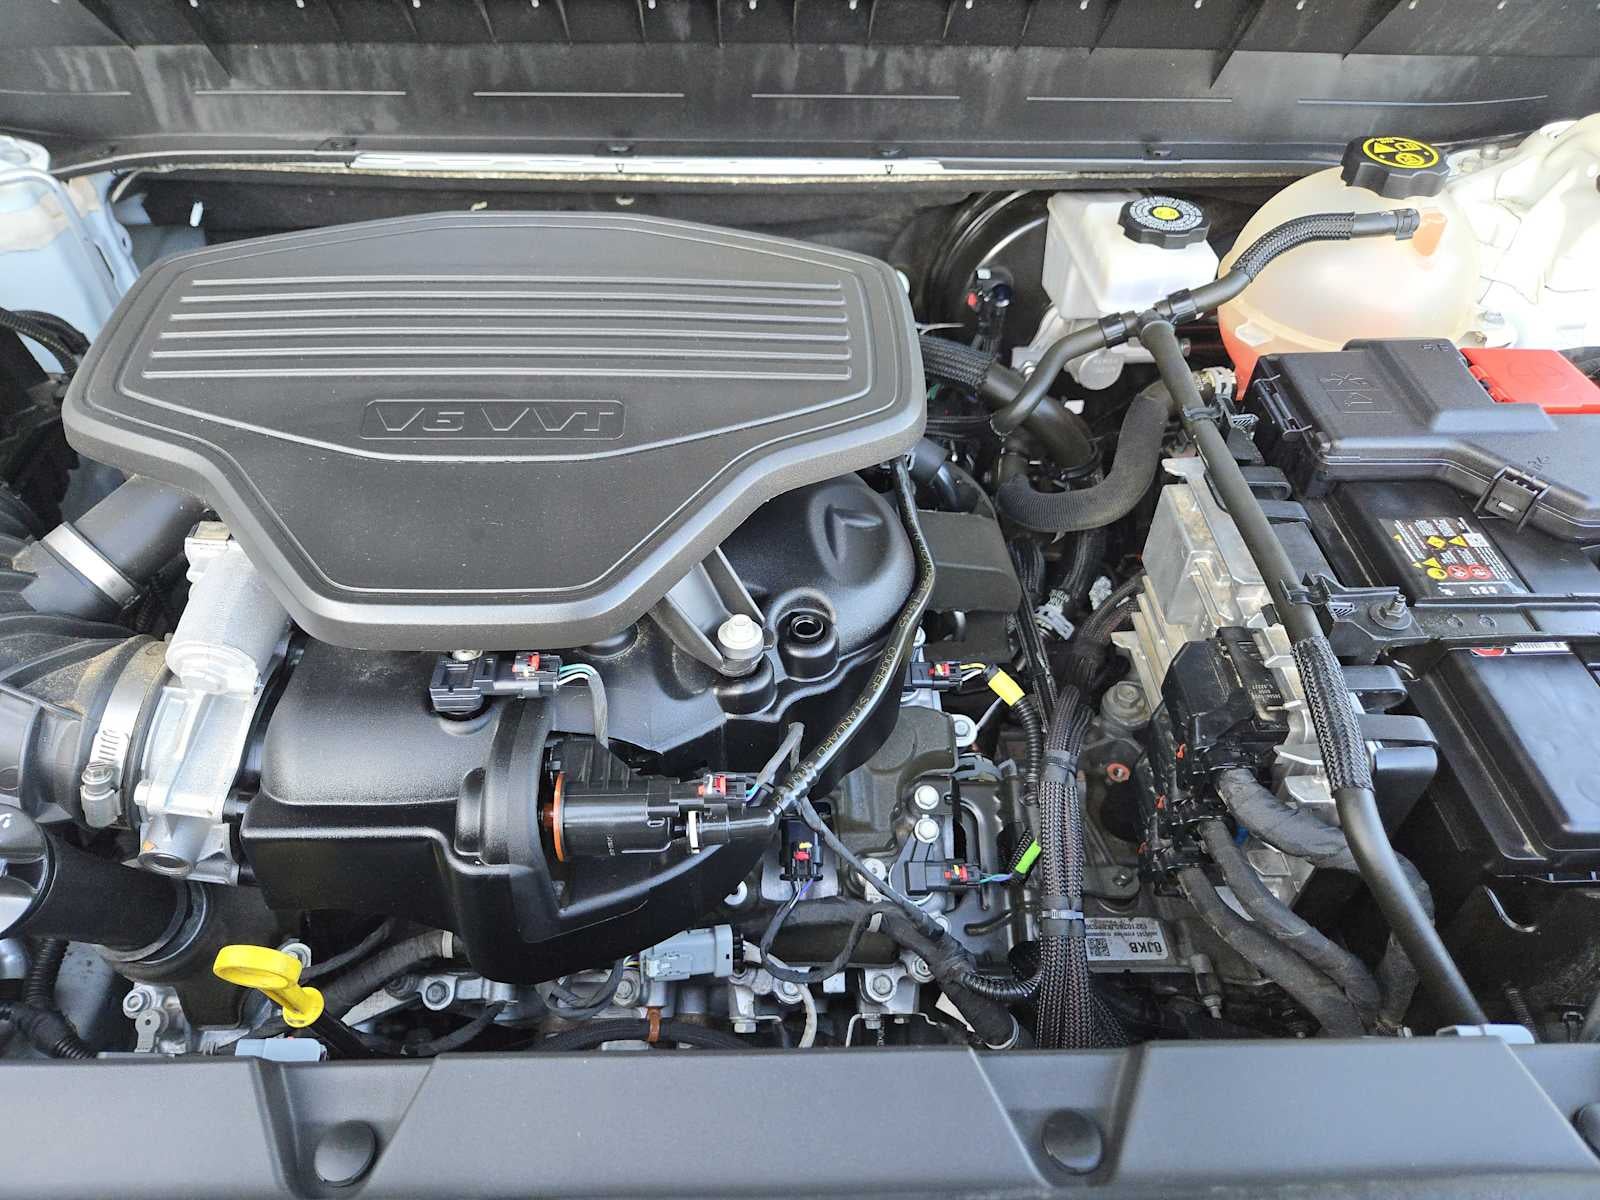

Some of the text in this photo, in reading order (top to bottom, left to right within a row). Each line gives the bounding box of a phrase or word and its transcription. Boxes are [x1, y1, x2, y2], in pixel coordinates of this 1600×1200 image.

[376, 407, 615, 432] V6 VVT
[871, 646, 897, 692] COOPER
[816, 695, 871, 758] STANDARD
